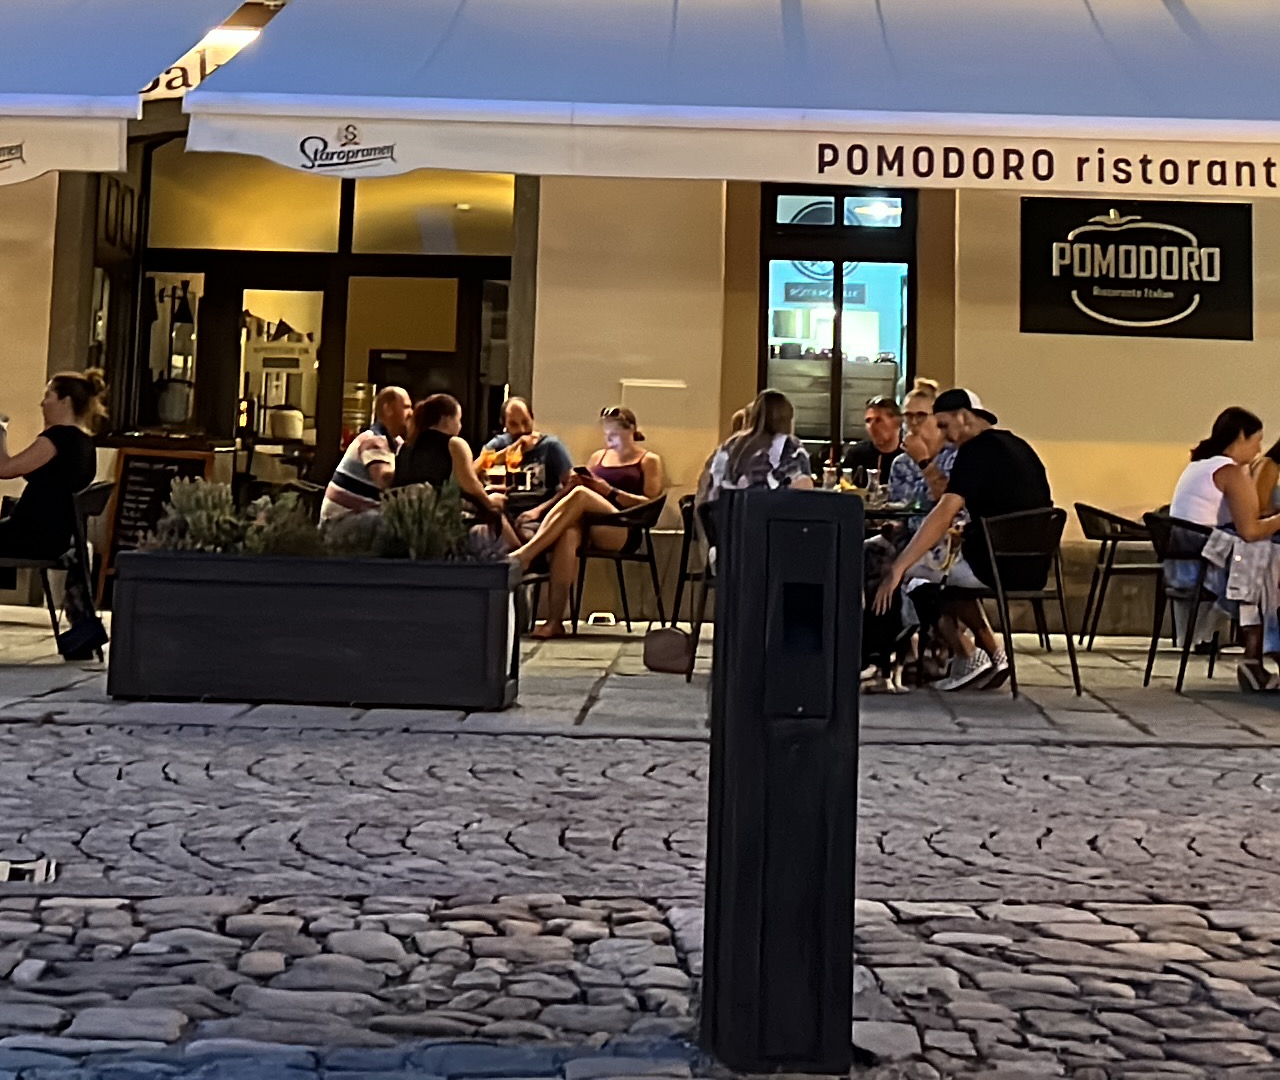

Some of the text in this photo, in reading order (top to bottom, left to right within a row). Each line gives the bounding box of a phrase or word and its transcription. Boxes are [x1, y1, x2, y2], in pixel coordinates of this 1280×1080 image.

[300, 136, 397, 169] Staropramen
[817, 143, 1056, 181] POMODORO
[1052, 242, 1220, 282] POMODORO
